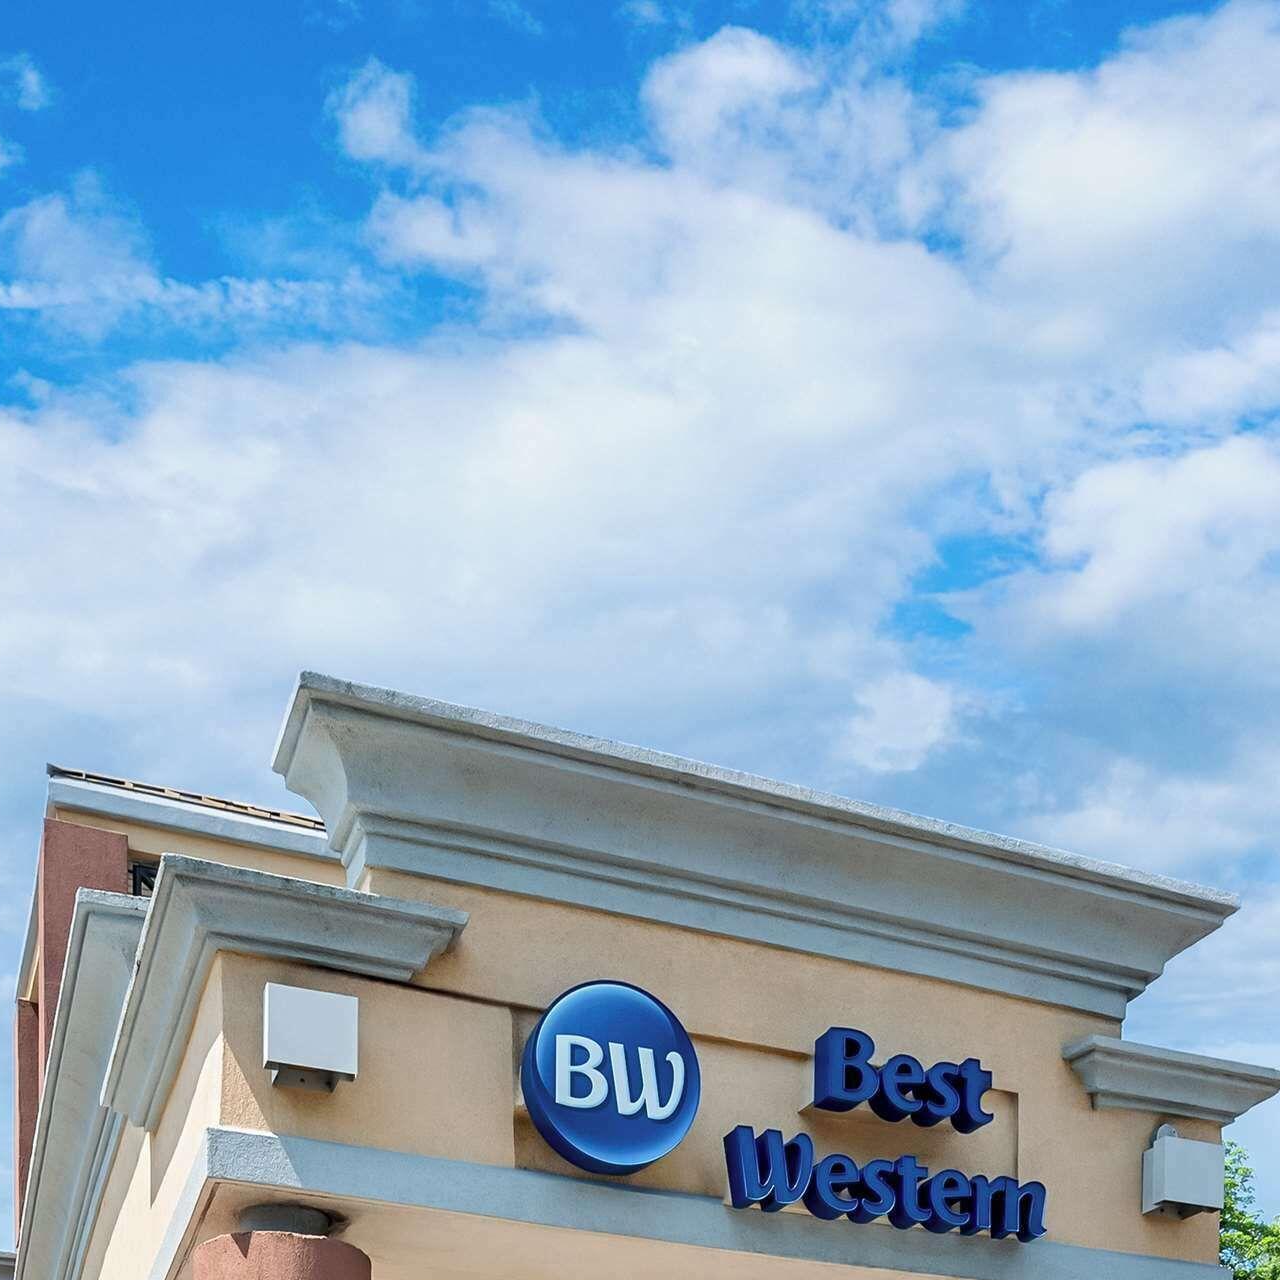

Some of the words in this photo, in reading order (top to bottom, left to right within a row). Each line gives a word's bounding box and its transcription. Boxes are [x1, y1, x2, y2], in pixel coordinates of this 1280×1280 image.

[555, 1034, 685, 1120] BW
[814, 1026, 994, 1134] Best
[723, 1125, 1048, 1243] Western
